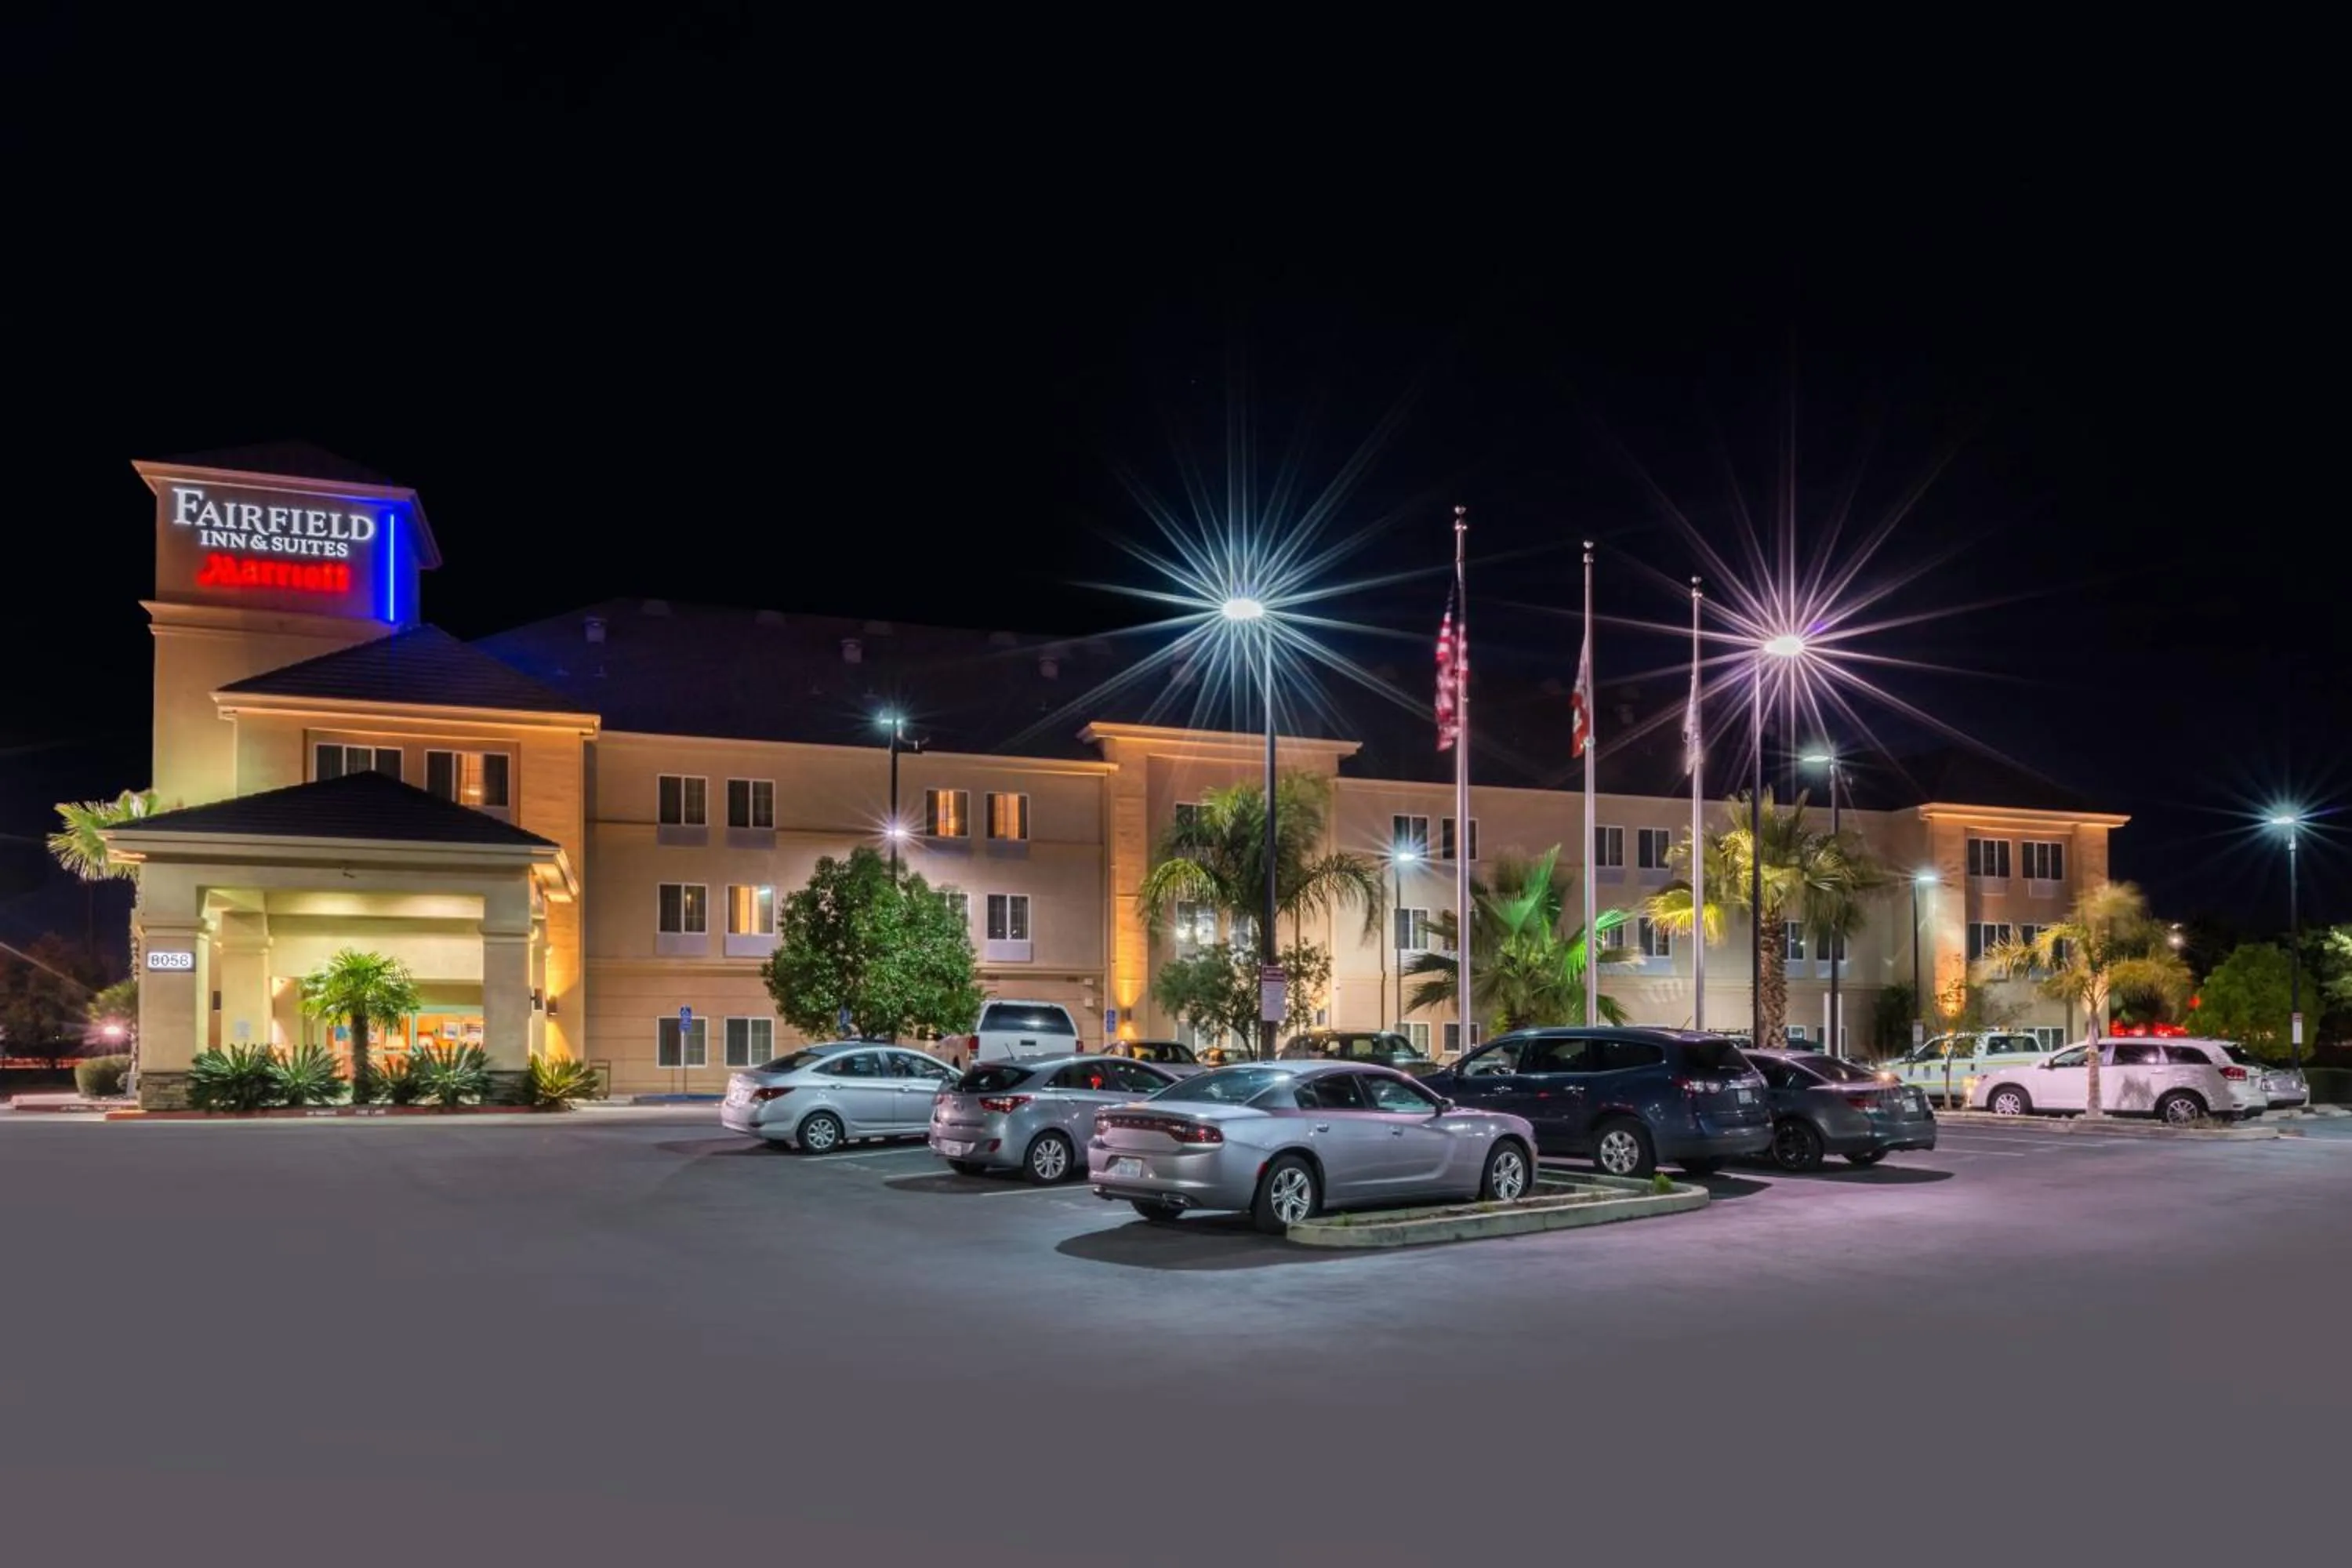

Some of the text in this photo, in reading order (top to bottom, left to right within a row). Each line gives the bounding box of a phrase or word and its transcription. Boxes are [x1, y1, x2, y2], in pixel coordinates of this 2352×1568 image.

[172, 488, 374, 541] FAIRFIELD
[200, 529, 349, 557] INN & SUITES
[198, 553, 350, 592] Marriott
